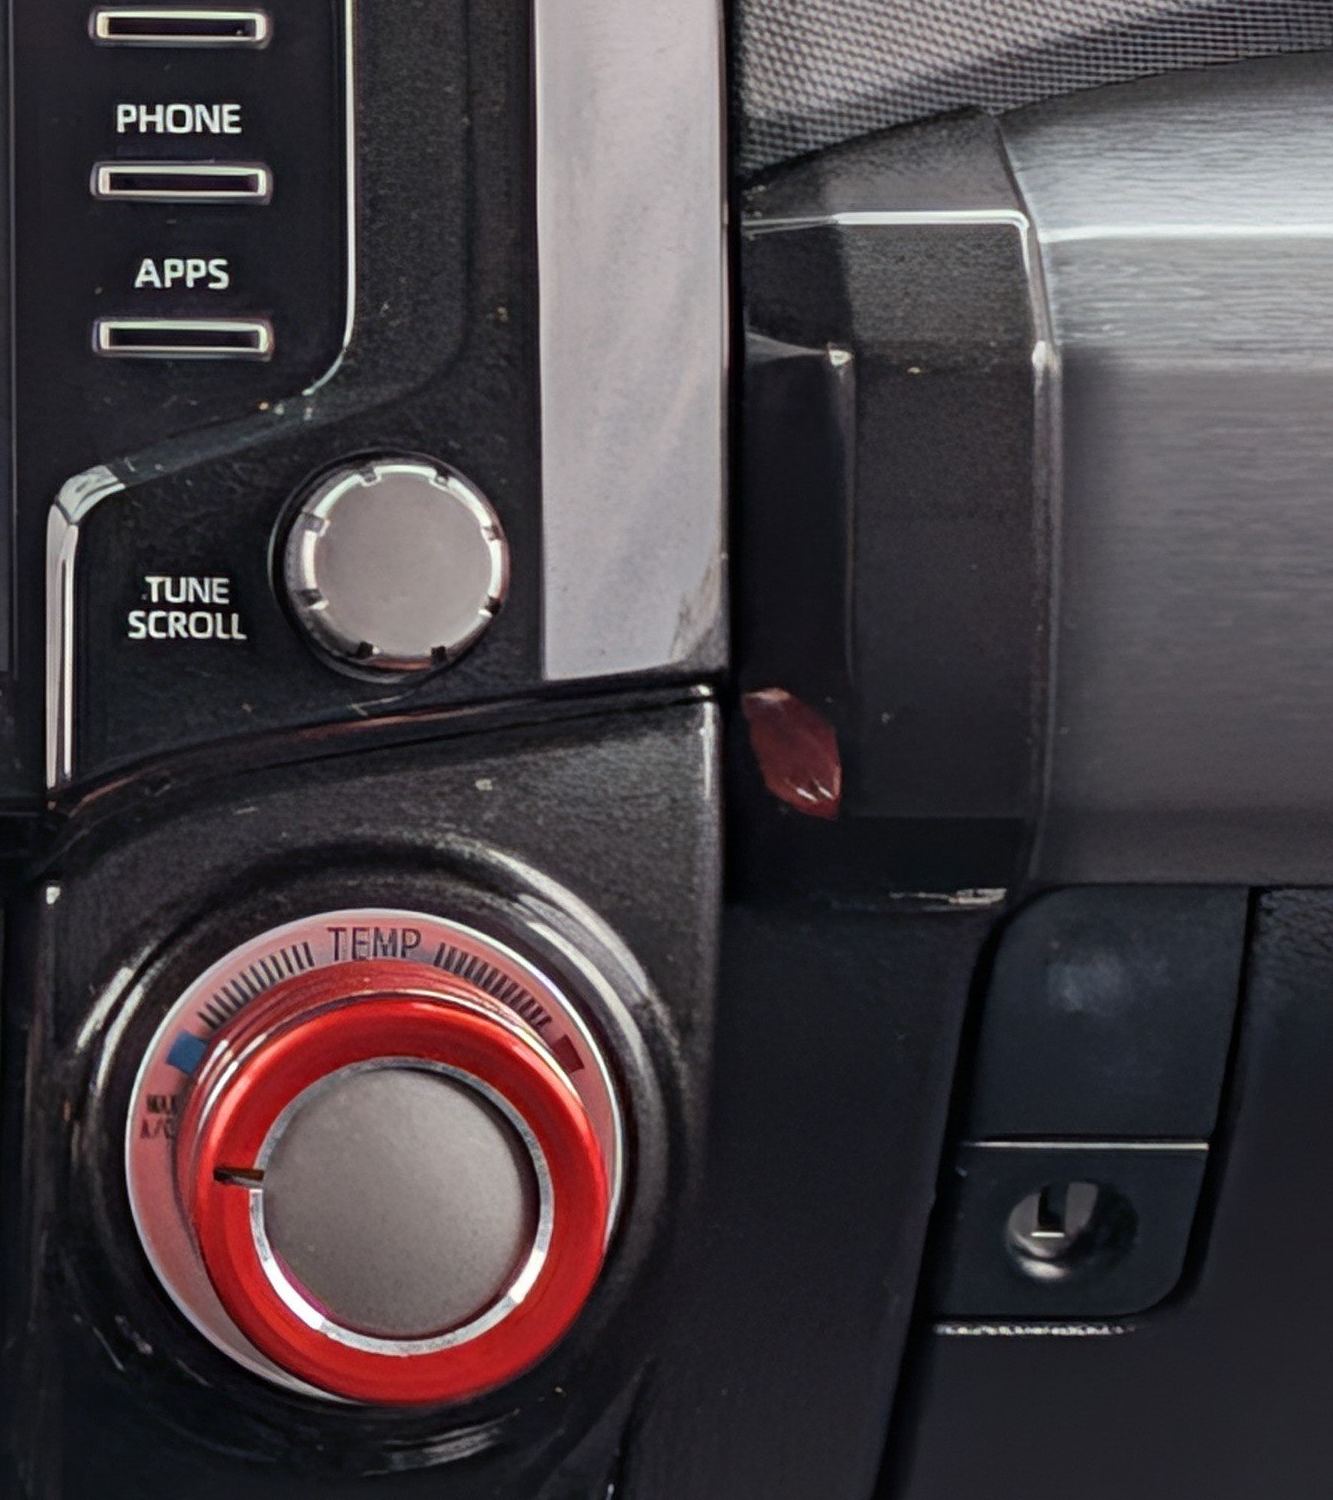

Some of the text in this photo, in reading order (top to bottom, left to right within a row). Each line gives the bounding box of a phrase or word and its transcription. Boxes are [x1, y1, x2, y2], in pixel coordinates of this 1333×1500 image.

[116, 103, 242, 134] PHONE
[134, 258, 229, 290] APPS
[144, 576, 230, 604] TUNE
[128, 610, 247, 640] SCROLL
[326, 926, 421, 960] TEMP
